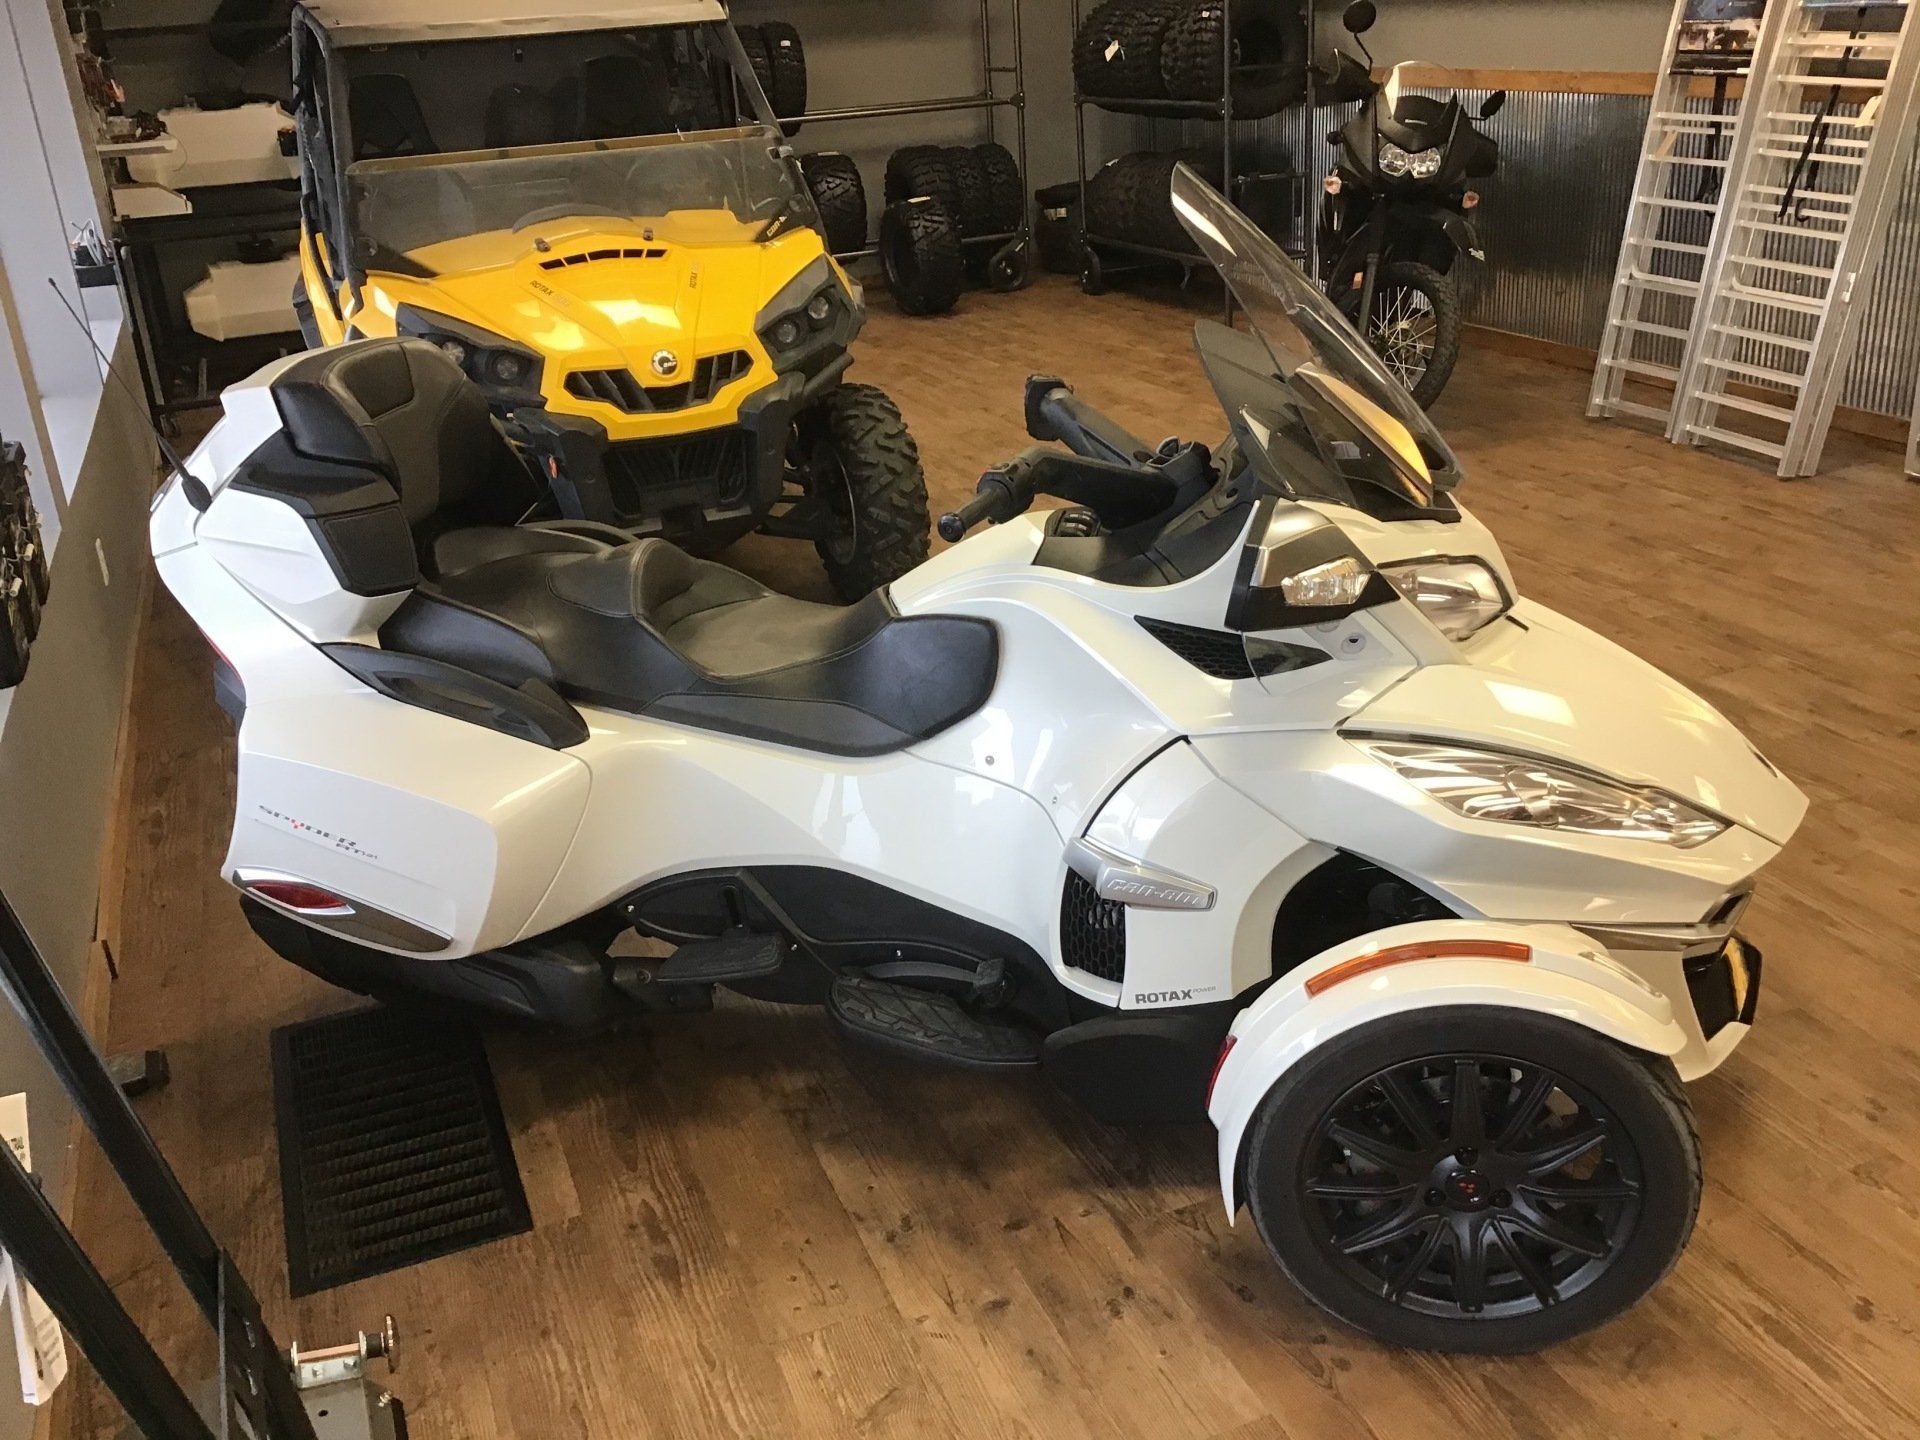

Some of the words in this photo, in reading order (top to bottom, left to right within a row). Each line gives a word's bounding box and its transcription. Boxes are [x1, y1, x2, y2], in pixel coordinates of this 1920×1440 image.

[529, 280, 554, 296] ROTAX
[259, 805, 357, 847] SPYDER
[1135, 989, 1193, 1004] ROTAX
